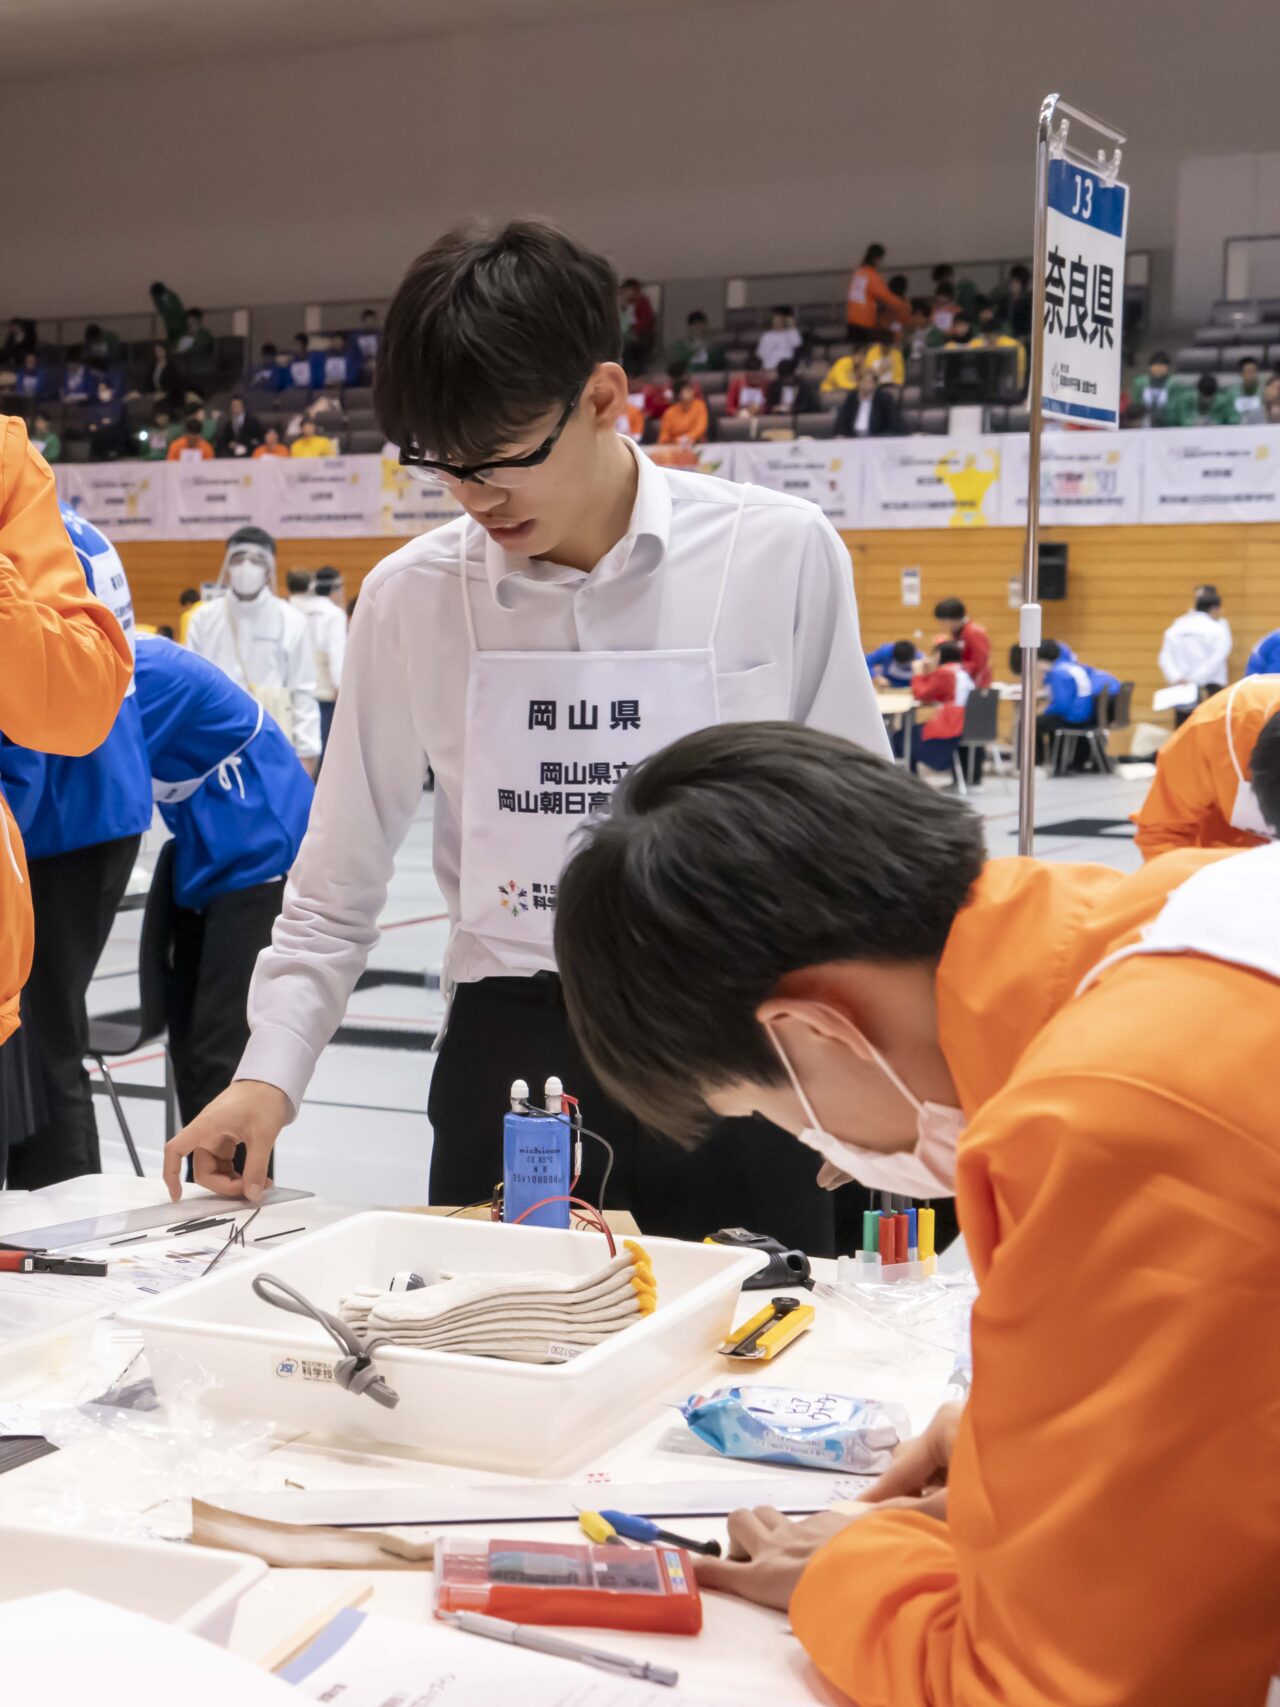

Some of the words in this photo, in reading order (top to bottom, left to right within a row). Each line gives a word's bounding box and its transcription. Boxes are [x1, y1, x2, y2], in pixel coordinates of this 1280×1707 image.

[1072, 175, 1093, 220] J3
[1044, 245, 1114, 349] 奈良県
[528, 700, 641, 730] 岡山県
